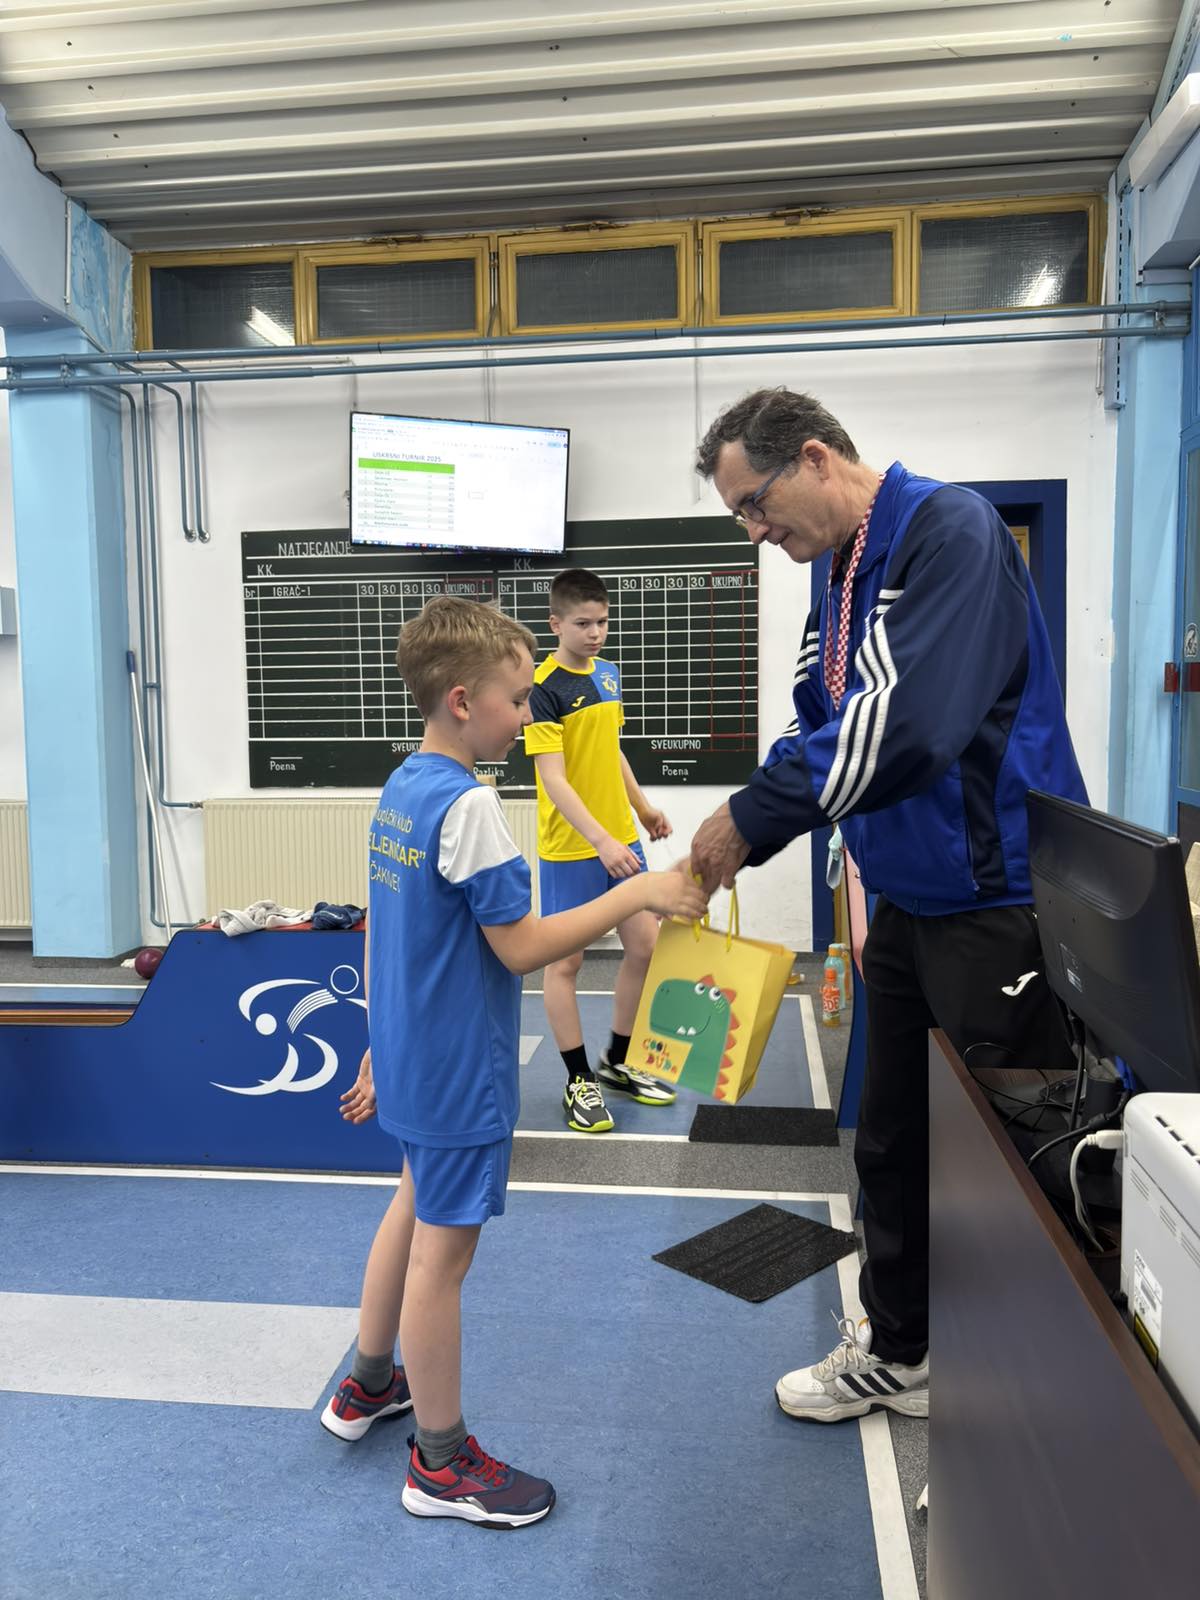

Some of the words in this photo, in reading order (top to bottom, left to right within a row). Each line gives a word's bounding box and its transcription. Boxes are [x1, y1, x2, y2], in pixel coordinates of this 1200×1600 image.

[500, 581, 512, 592] br
[622, 578, 637, 589] 30
[645, 578, 660, 589] 30
[667, 577, 683, 588] 30
[690, 576, 705, 588] 30
[712, 575, 743, 588] UKUPNO
[245, 587, 256, 598] br
[360, 584, 375, 595] 30
[382, 584, 396, 595] 30
[404, 583, 419, 594] 30
[425, 583, 441, 594] 30
[445, 583, 475, 594] UKUPNO
[650, 739, 702, 750] SVEUKUPNO
[270, 760, 296, 771] Poena
[662, 764, 689, 776] Poena
